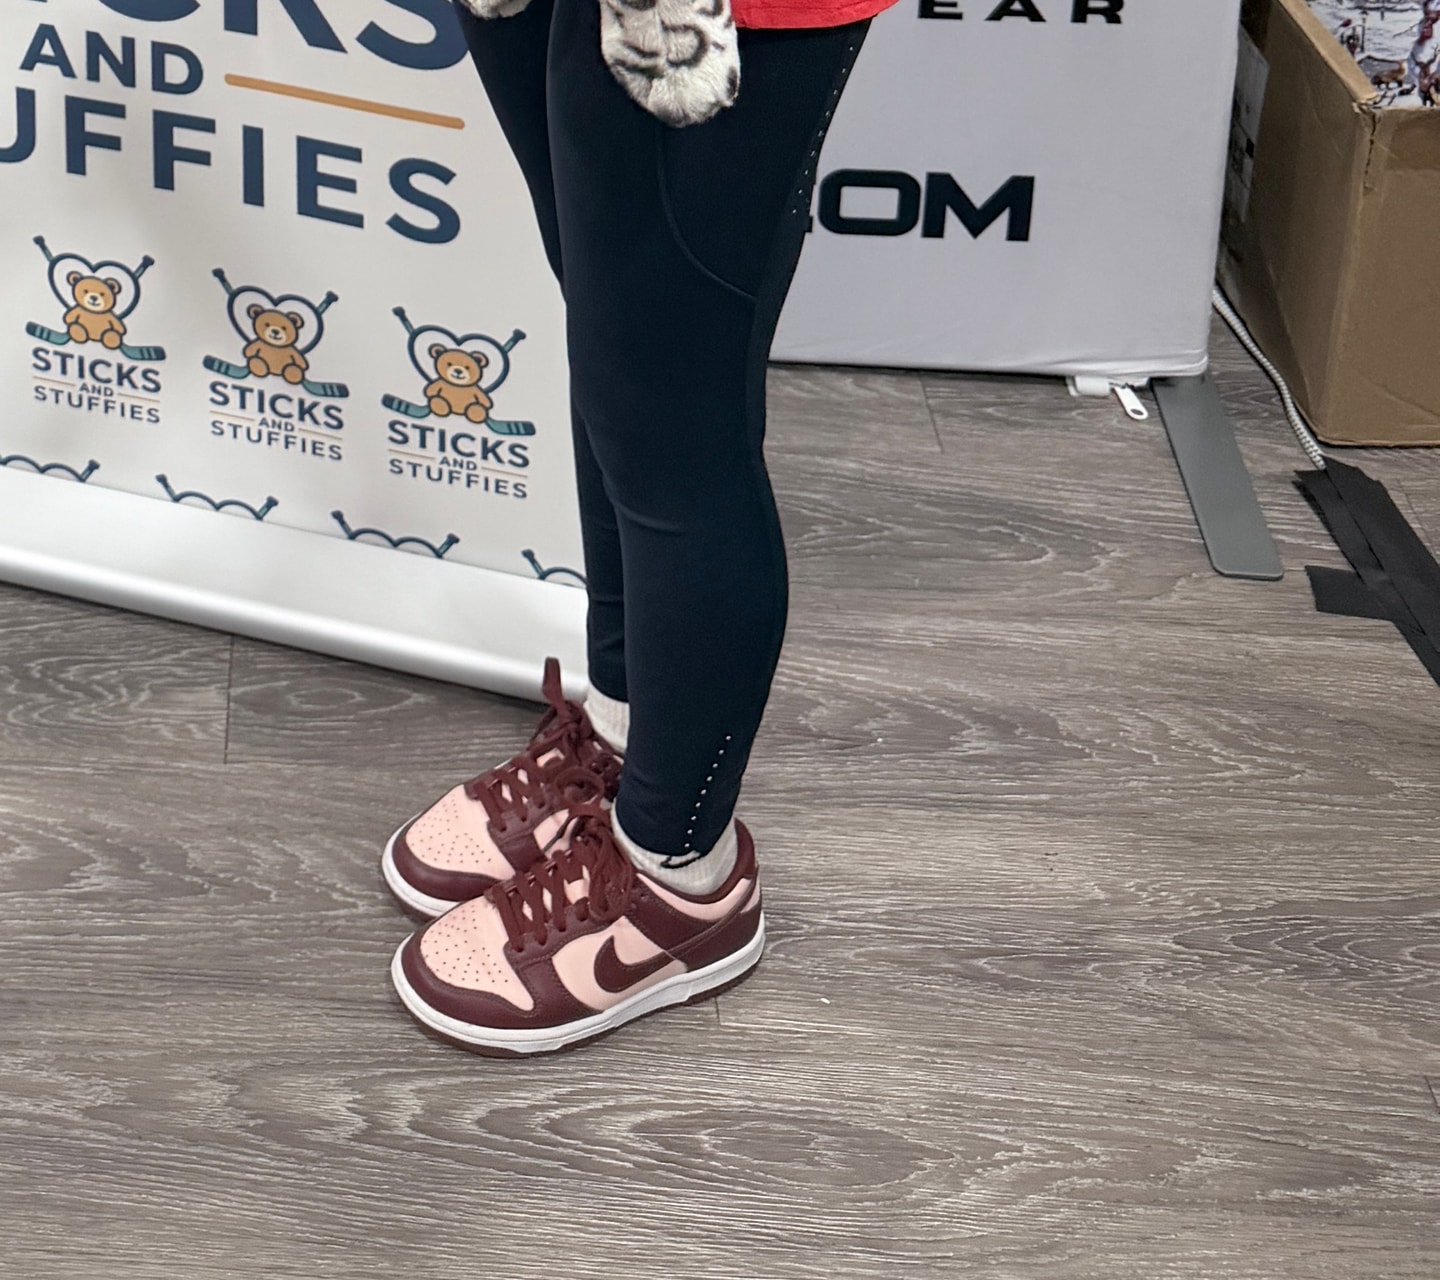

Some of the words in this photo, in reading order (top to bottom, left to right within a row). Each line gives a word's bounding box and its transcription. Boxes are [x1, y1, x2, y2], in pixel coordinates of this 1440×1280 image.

[20, 24, 205, 96] AND
[31, 346, 163, 396] STICKS
[78, 380, 116, 398] AND
[33, 382, 162, 426] STUFFIES
[208, 381, 345, 431] STICKS
[258, 415, 296, 434] AND
[210, 419, 344, 462] STUFFIES
[387, 419, 530, 470] STICKS
[388, 458, 529, 501] STUFFIES
[438, 455, 478, 473] AND
